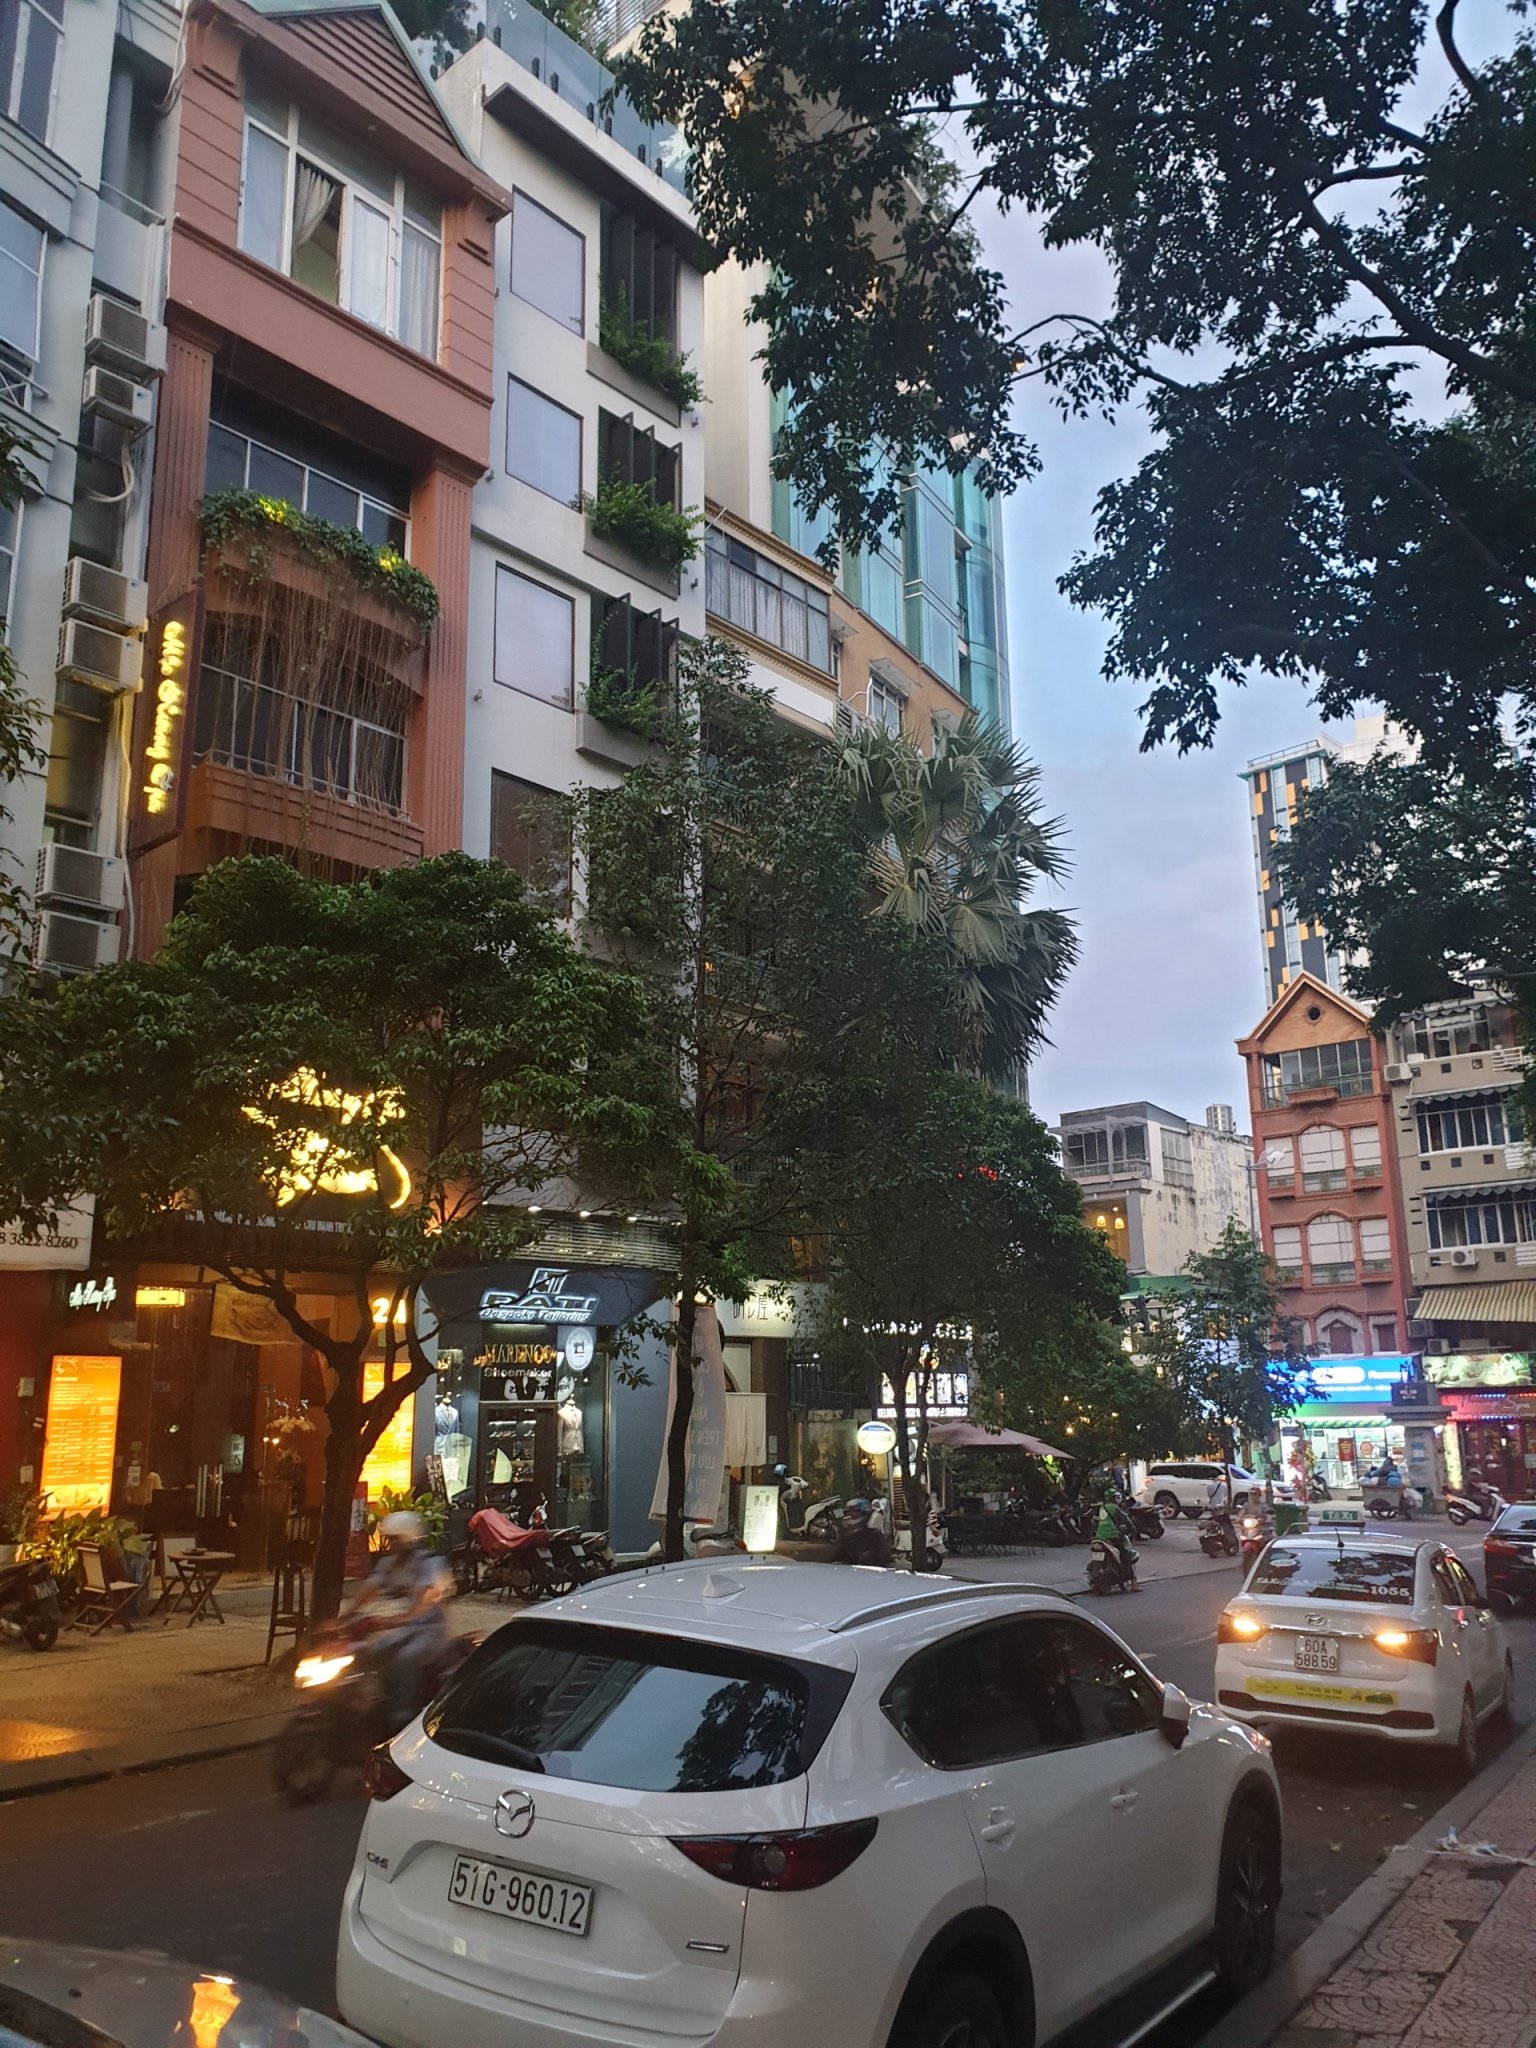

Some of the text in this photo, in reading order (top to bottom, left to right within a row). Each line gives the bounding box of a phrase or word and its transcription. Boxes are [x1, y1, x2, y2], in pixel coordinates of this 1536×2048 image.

[45, 1235, 79, 1249] 8260
[484, 1367, 553, 1378] Shoemaker
[1370, 1585, 1410, 1597] 1055
[1304, 1639, 1328, 1655] 60A
